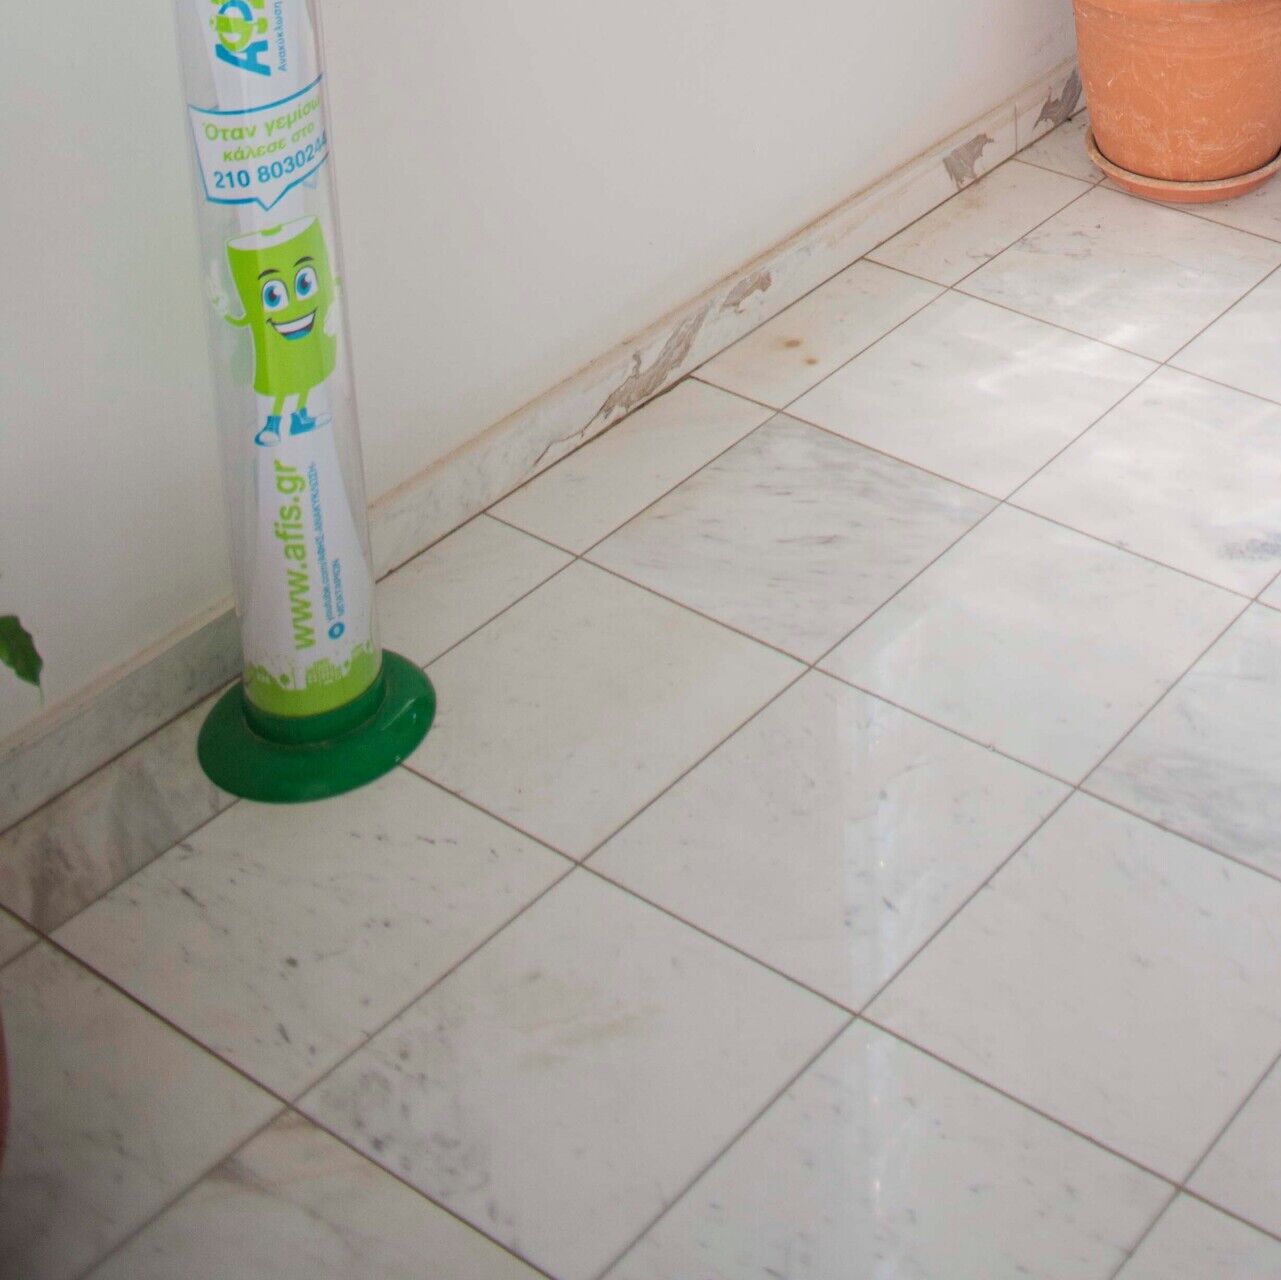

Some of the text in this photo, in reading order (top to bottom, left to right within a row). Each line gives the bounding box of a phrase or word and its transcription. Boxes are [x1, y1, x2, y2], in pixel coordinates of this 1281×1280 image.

[224, 122, 314, 162] κάλεσε στο
[214, 169, 250, 188] 210
[274, 459, 316, 650] www.afis.gr
